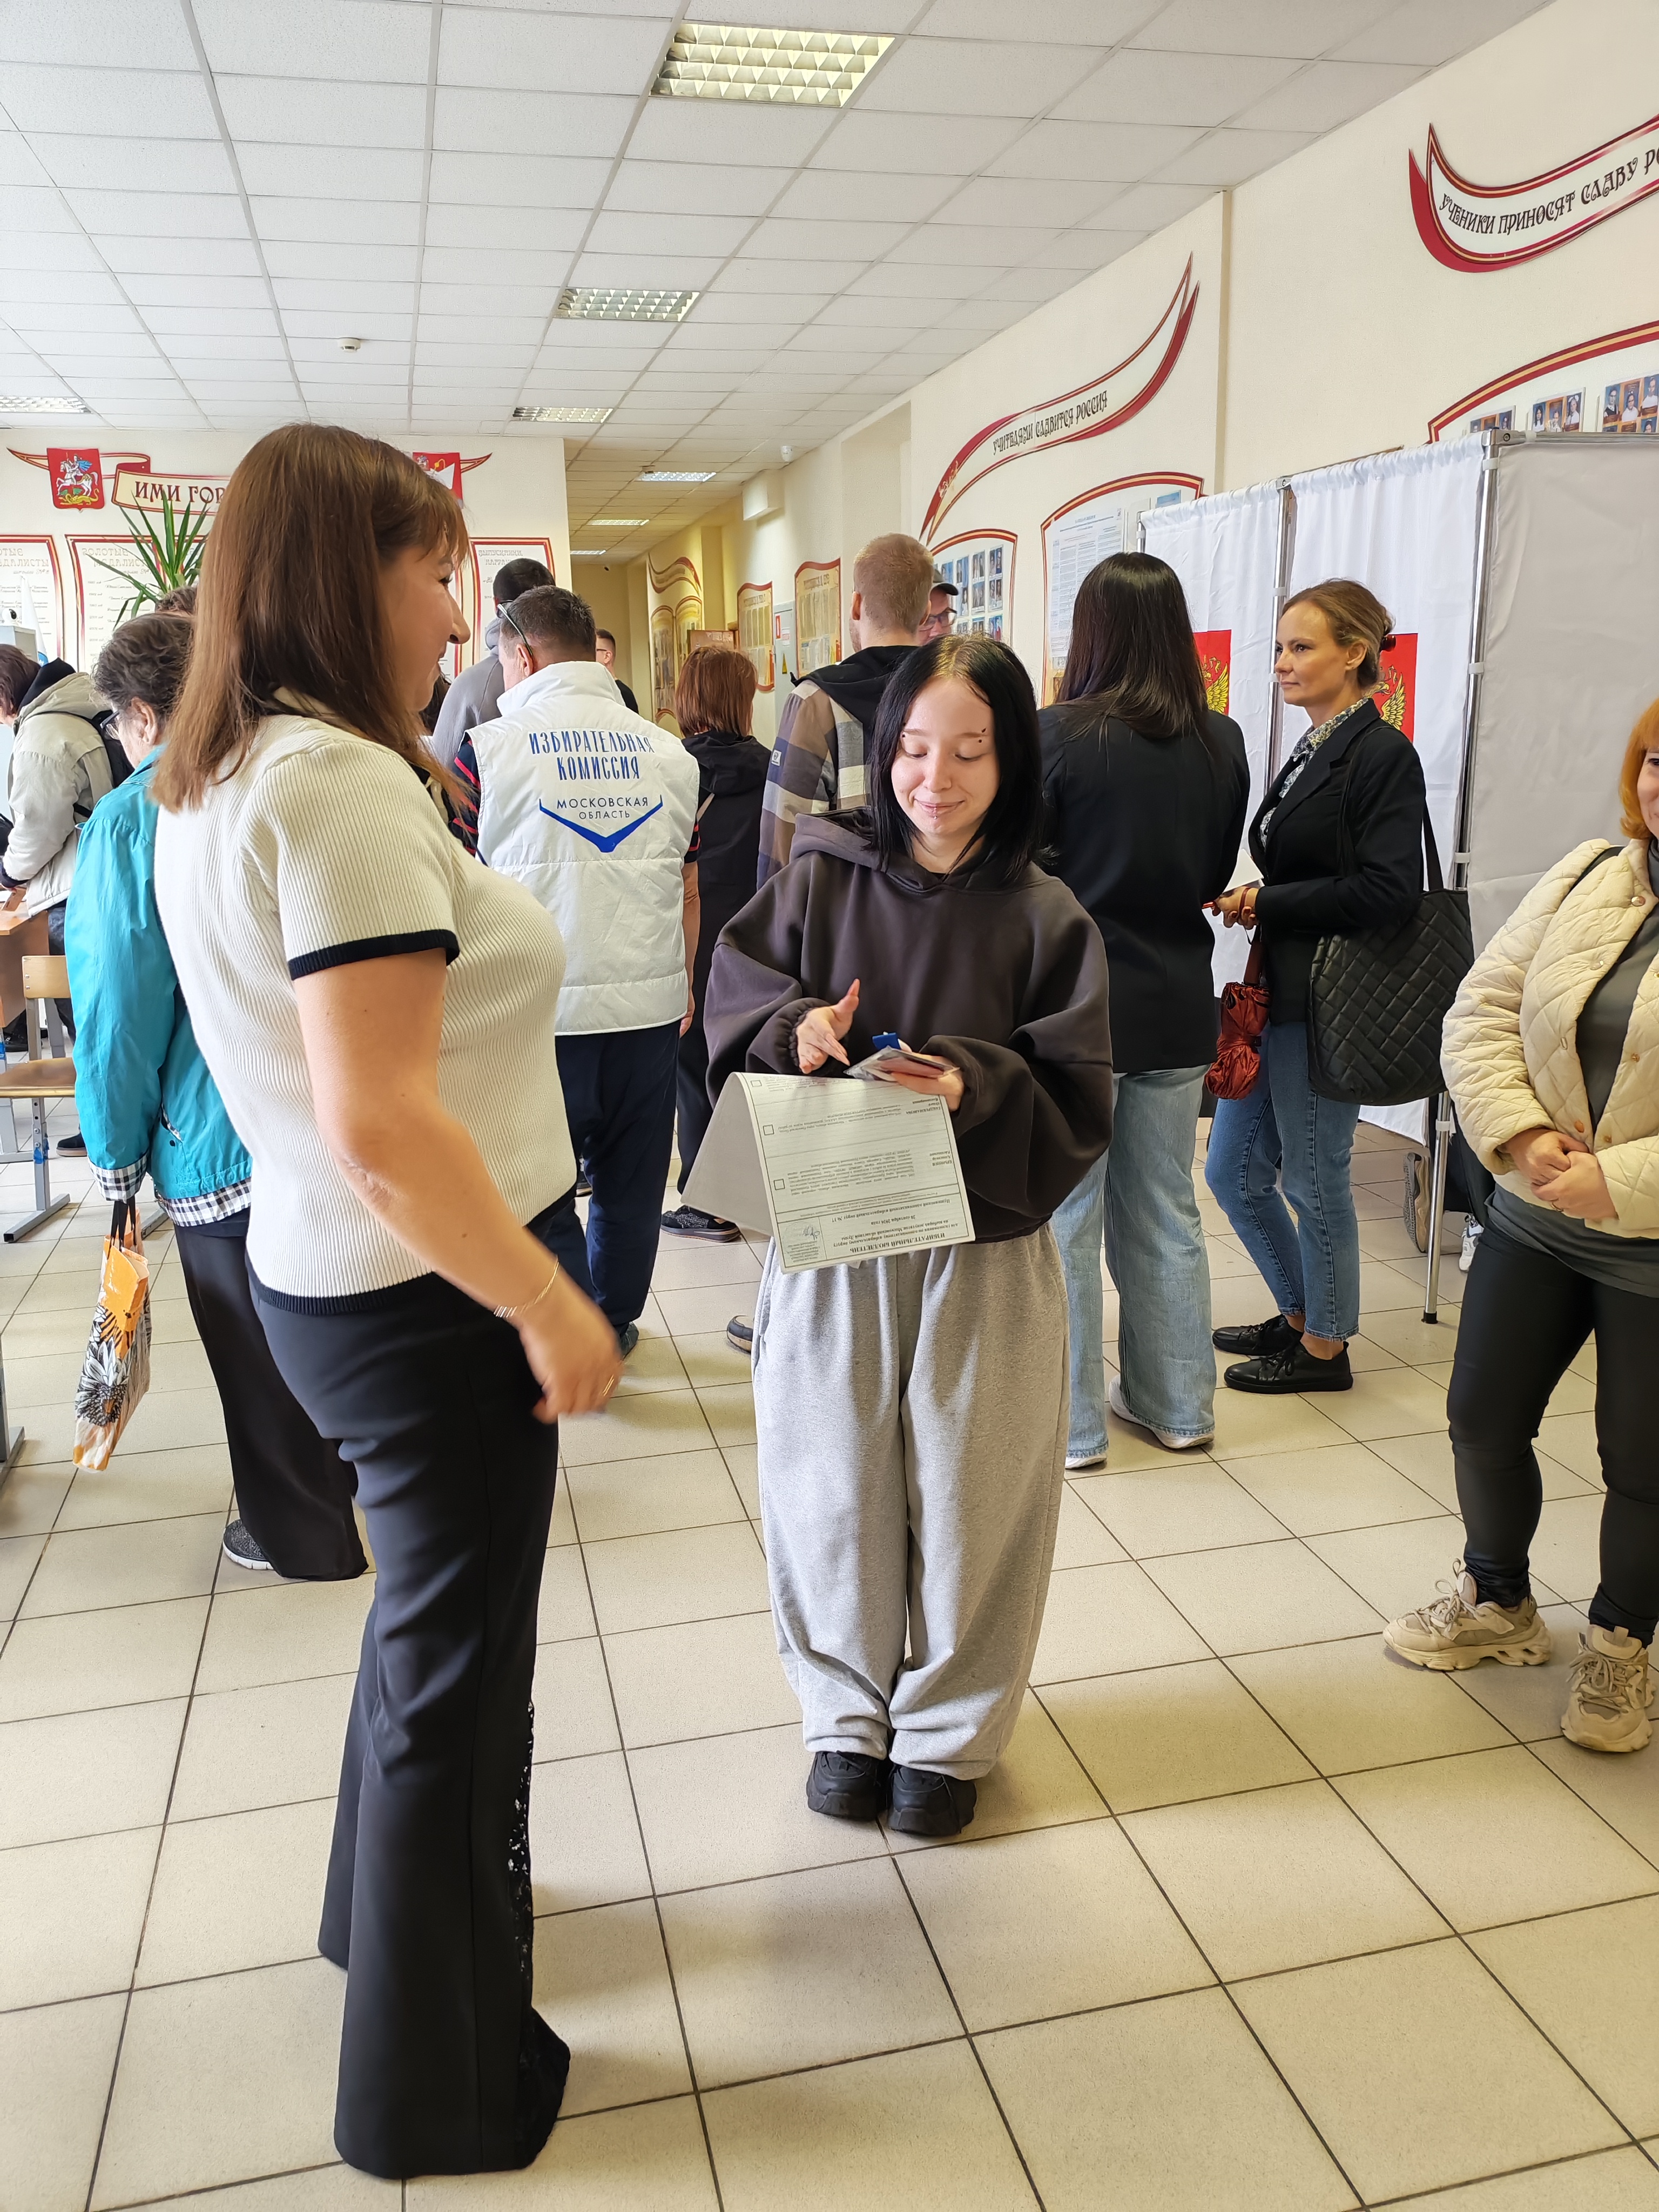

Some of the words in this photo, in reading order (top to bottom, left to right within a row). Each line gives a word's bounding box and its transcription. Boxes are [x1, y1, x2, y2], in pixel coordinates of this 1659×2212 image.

[1439, 193, 1496, 234] УЧЕНИКИ
[1498, 190, 1575, 235] ПРИНОСЯТ
[1581, 157, 1638, 204] СЛАВУ
[1644, 146, 1659, 175] Р
[993, 423, 1033, 455] УЧИТЕЛЯМИ
[1036, 408, 1074, 437] СЛАВИТСЯ
[1076, 390, 1108, 424] РОССИЯ
[135, 481, 181, 502] ИМИ
[529, 730, 655, 754] ИЗБИРАТЕЛЬНАЯ
[557, 756, 640, 780] КОМИССИЯ
[557, 797, 649, 809] МОСКОВСКАЯ
[579, 811, 630, 819] ОБЛАСТЬ
[849, 1242, 889, 1253] БЮЛЛЕТЕНЬ
[891, 1232, 945, 1246] ИЗБИРАТЕЛЬНЫЙ
